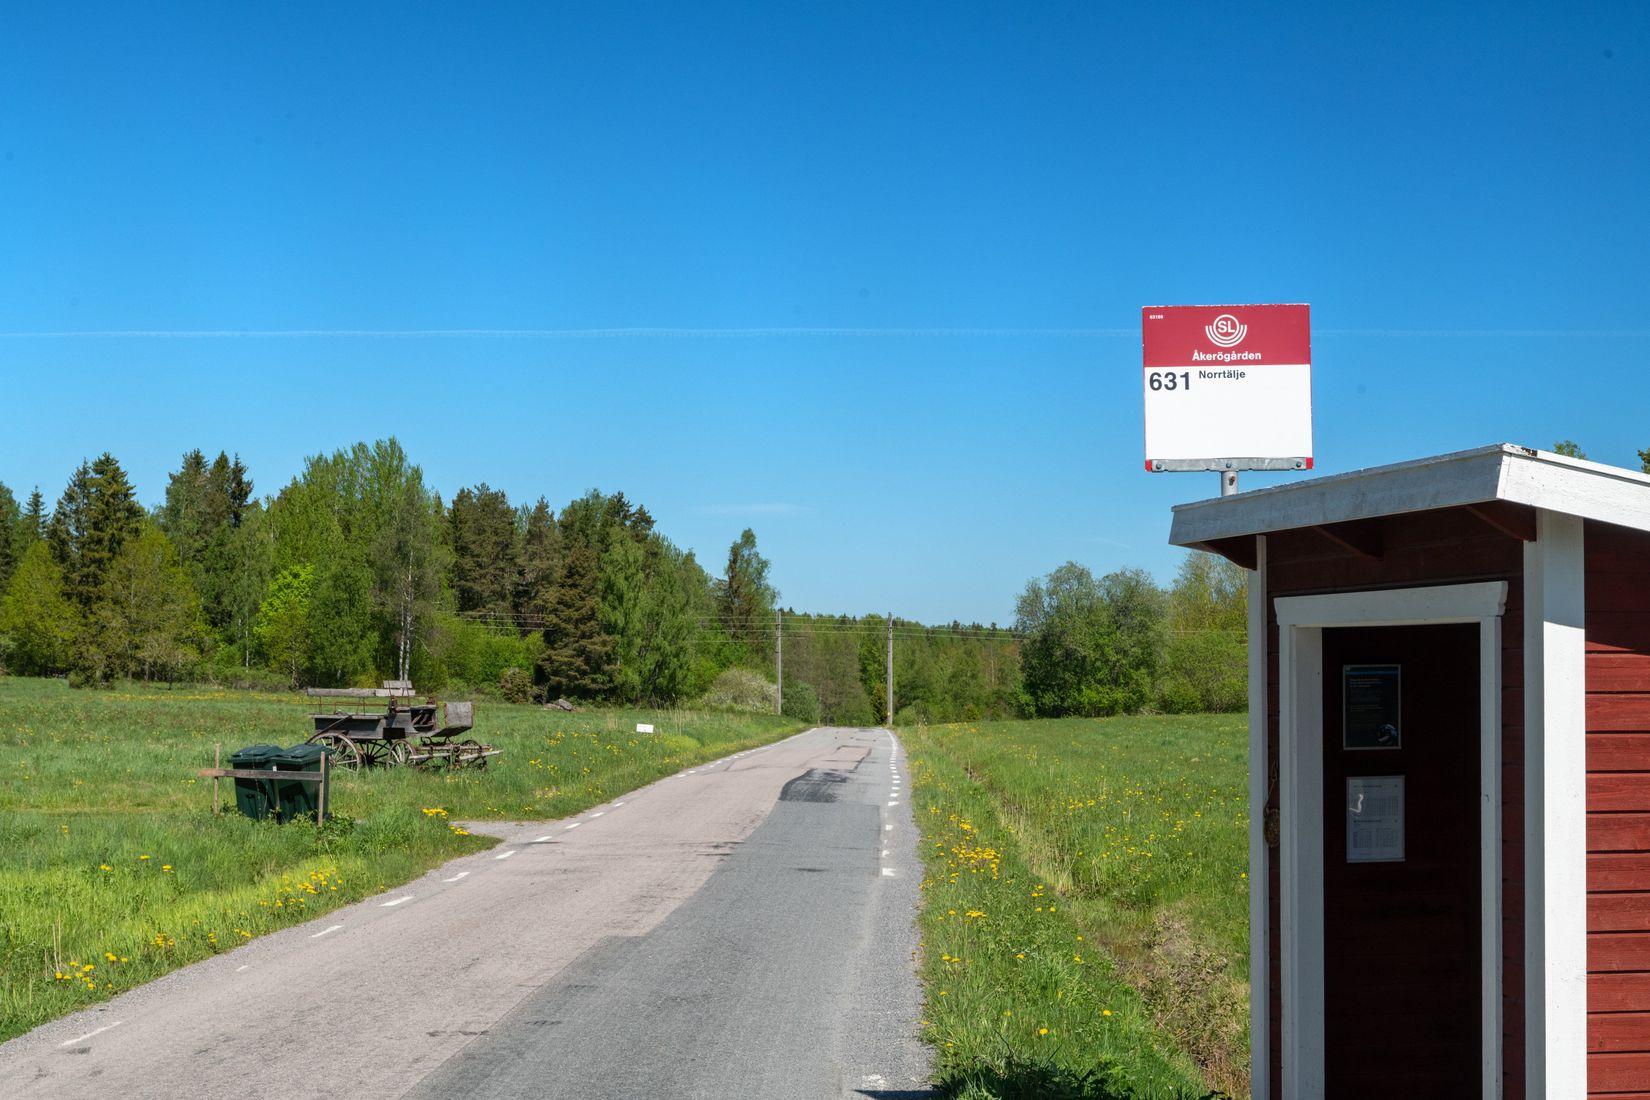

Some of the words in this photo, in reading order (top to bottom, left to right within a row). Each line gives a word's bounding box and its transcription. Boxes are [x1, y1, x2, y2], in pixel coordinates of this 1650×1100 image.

[1218, 321, 1235, 333] SL
[1193, 350, 1261, 362] Åkerögården
[1150, 371, 1190, 391] 631
[1199, 370, 1245, 380] Norrtälje
